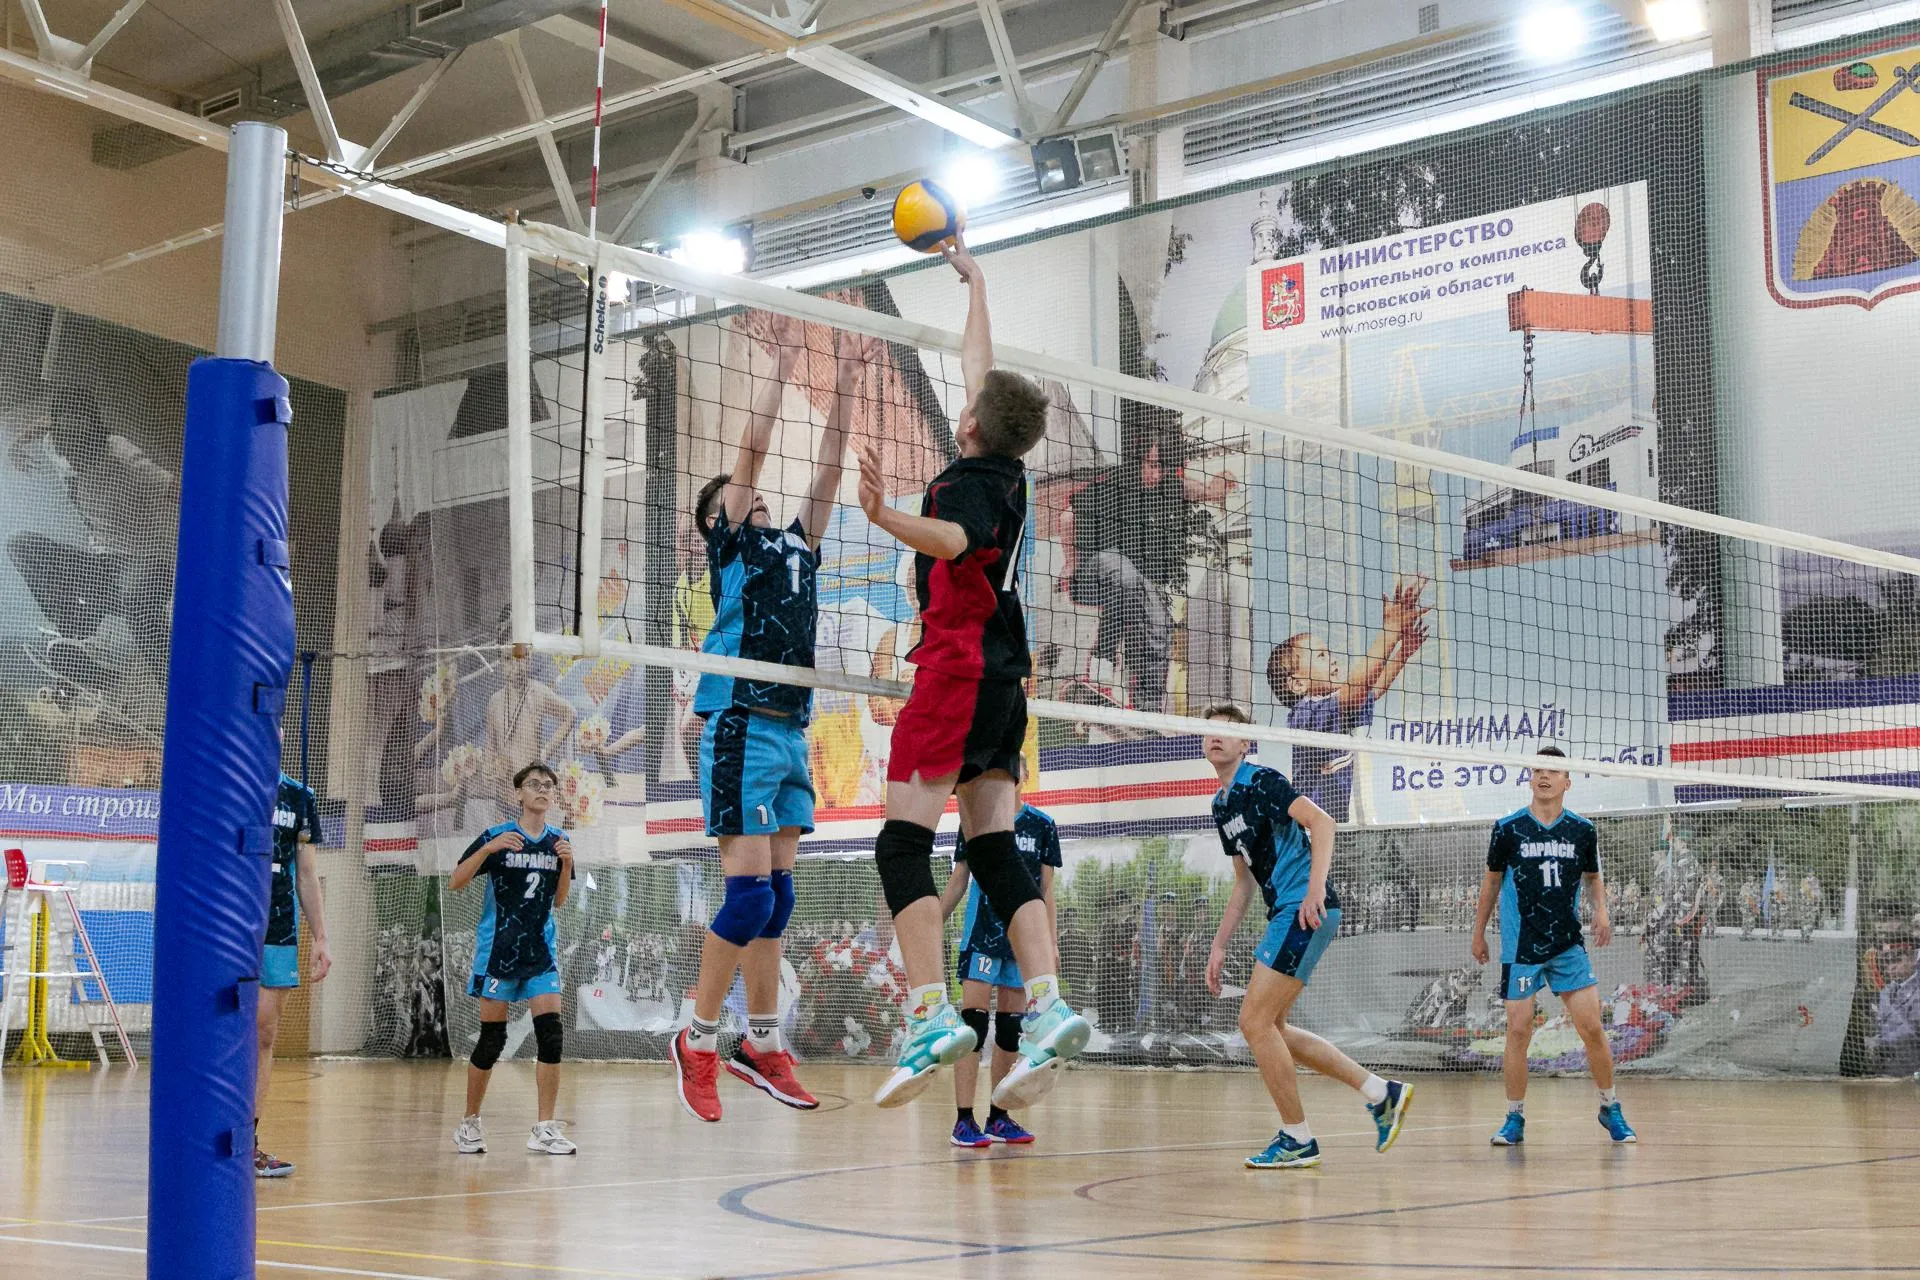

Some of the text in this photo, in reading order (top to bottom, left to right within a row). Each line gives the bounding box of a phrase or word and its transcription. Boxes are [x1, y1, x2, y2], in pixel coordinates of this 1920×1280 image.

[1319, 218, 1514, 276] МИНИСТЕРСТВО
[1319, 237, 1567, 298] строительного комплекса
[1320, 271, 1515, 321] Московской области
[594, 291, 607, 355] Schelde
[1320, 310, 1423, 339] www.mosreg.ru
[786, 550, 800, 594] 1
[1389, 702, 1566, 746] ПРИНИМАЙ!
[1391, 761, 1445, 791] Всё
[0, 784, 160, 828] Мы строи
[756, 804, 769, 825] 1
[1520, 841, 1575, 859] ЗАРАЙСК
[524, 871, 541, 899] 2
[1538, 860, 1562, 888] 11
[978, 956, 993, 975] 12
[488, 978, 499, 993] 2
